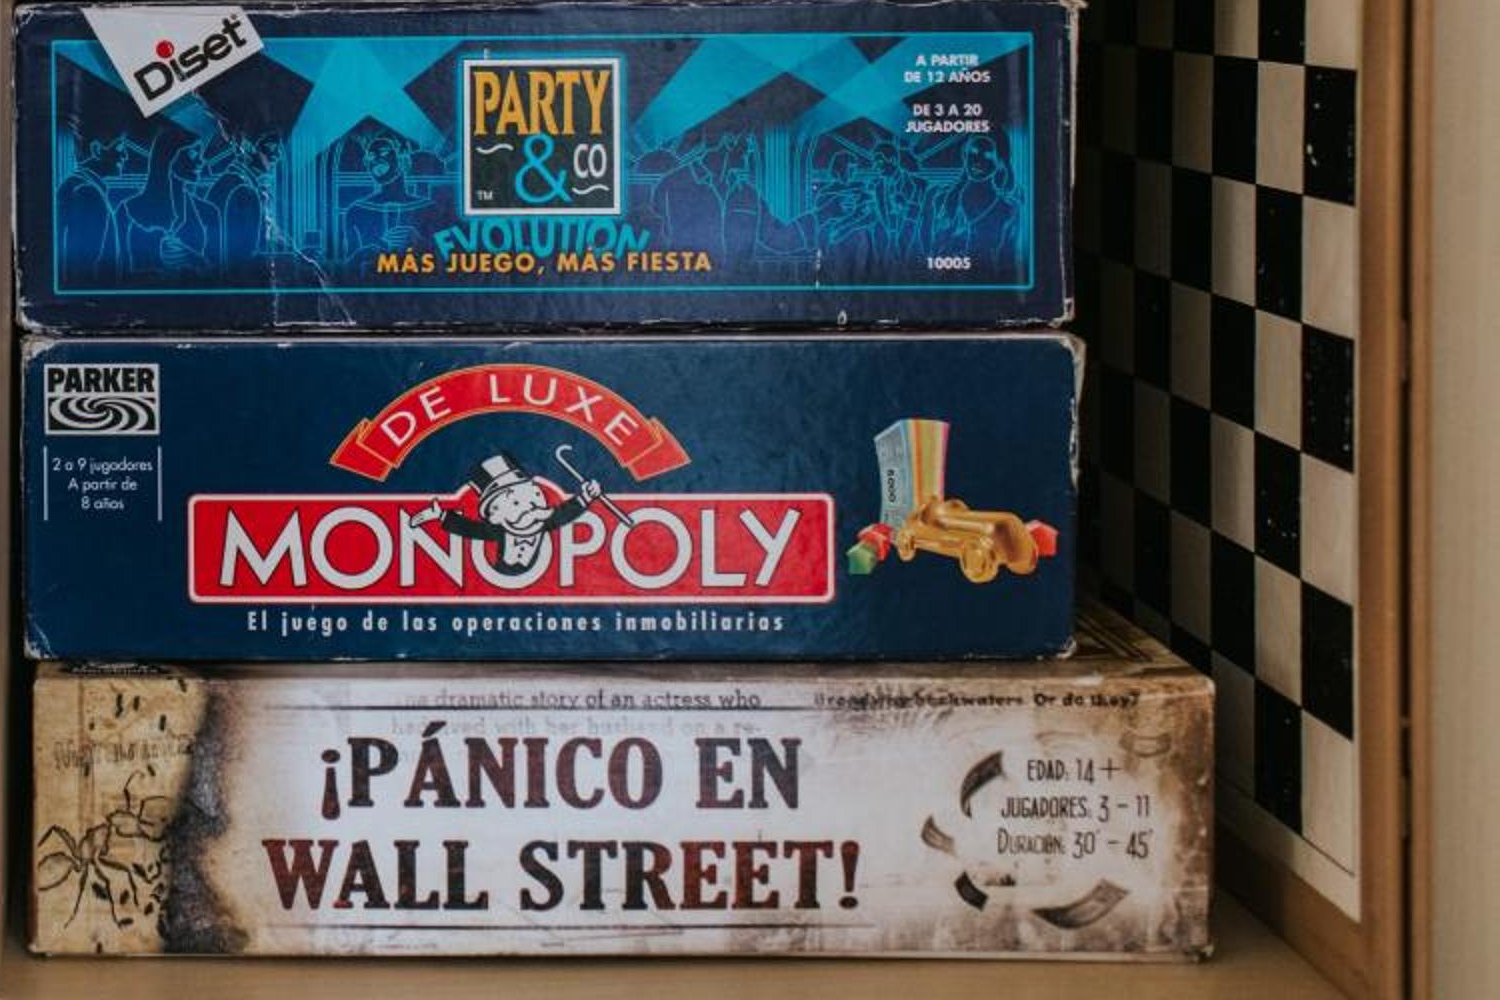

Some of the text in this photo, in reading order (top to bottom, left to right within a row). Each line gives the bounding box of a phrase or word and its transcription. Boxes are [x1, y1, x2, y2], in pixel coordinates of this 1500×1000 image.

[133, 18, 247, 101] Diset
[916, 54, 979, 67] A PARTIR
[904, 67, 991, 83] DE 12 AÑOS
[473, 70, 611, 136] PARTY
[913, 103, 982, 117] DE 3 A 20
[905, 120, 990, 133] JUGADORES
[515, 133, 608, 204] & CO
[377, 249, 712, 275] MÁS JUEGO, MÁS FIESTA
[48, 367, 154, 393] PARKER
[381, 373, 637, 447] DE LUXE
[53, 458, 61, 471] 2
[78, 458, 87, 471] 9
[90, 457, 153, 475] jugadores
[68, 476, 138, 494] A partir de
[82, 496, 124, 509] 8 años
[219, 505, 802, 591] MONOPOLY
[247, 611, 785, 637] El juego de las operaciones inmobiliarias
[717, 688, 761, 707] who
[321, 721, 801, 820] ¡PÁNICO EN
[1098, 795, 1109, 822] 3
[262, 838, 862, 911] WALL STREET!
